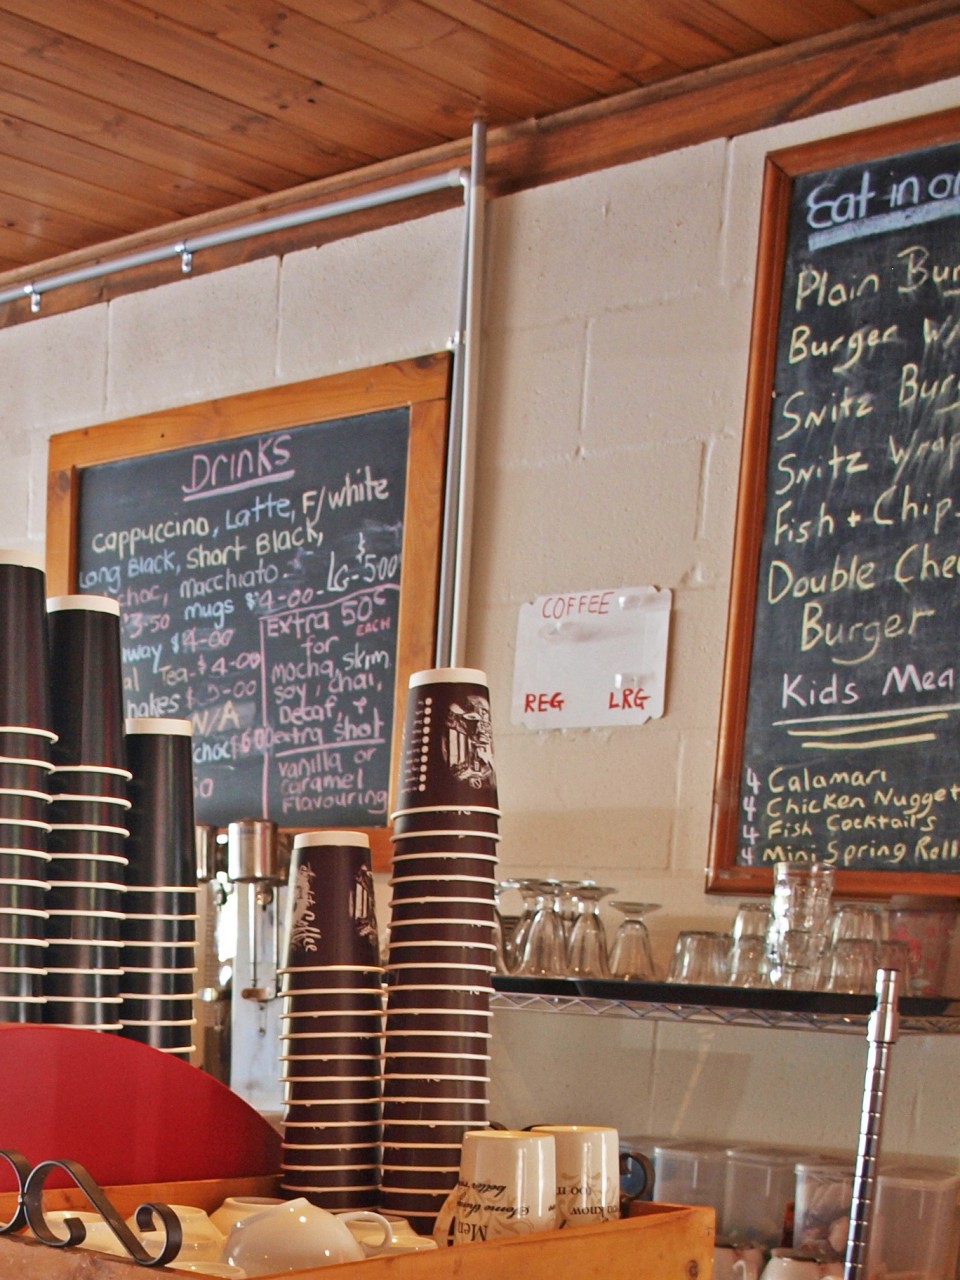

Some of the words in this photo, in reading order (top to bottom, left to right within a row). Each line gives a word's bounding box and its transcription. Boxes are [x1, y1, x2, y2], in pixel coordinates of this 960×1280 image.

[806, 170, 875, 230] Eat
[884, 171, 920, 208] in
[796, 268, 879, 311] Plain
[897, 245, 960, 297] Bur
[789, 323, 898, 373] Burger
[777, 386, 874, 440] Snitz
[899, 362, 960, 415] Bur
[775, 445, 868, 496] Snitz
[302, 465, 390, 530] F/white
[774, 500, 835, 546] Fish
[873, 484, 960, 536] Chip
[768, 554, 876, 605] Double
[894, 543, 960, 593] Che
[184, 598, 235, 630] mugs
[542, 591, 616, 619] COFFEE
[267, 611, 331, 640] Extra
[356, 617, 392, 637] EACH
[801, 602, 936, 666] Burger
[301, 635, 340, 658] for
[126, 691, 181, 719] hakes
[524, 692, 565, 713] REG
[609, 688, 651, 710] LRG
[781, 672, 860, 708] Kids
[191, 699, 241, 738] N/A
[273, 726, 324, 746] extra
[334, 706, 385, 743] shot
[353, 747, 378, 765] or
[746, 767, 761, 795] 4
[768, 766, 888, 793] Calamari
[743, 796, 757, 822] 4
[767, 792, 866, 818] Chicken
[743, 824, 759, 845] 4
[768, 819, 814, 840] Fish
[826, 813, 939, 833] Cocktails
[741, 846, 754, 866] 4
[763, 844, 817, 864] Mini
[824, 840, 907, 867] Spring
